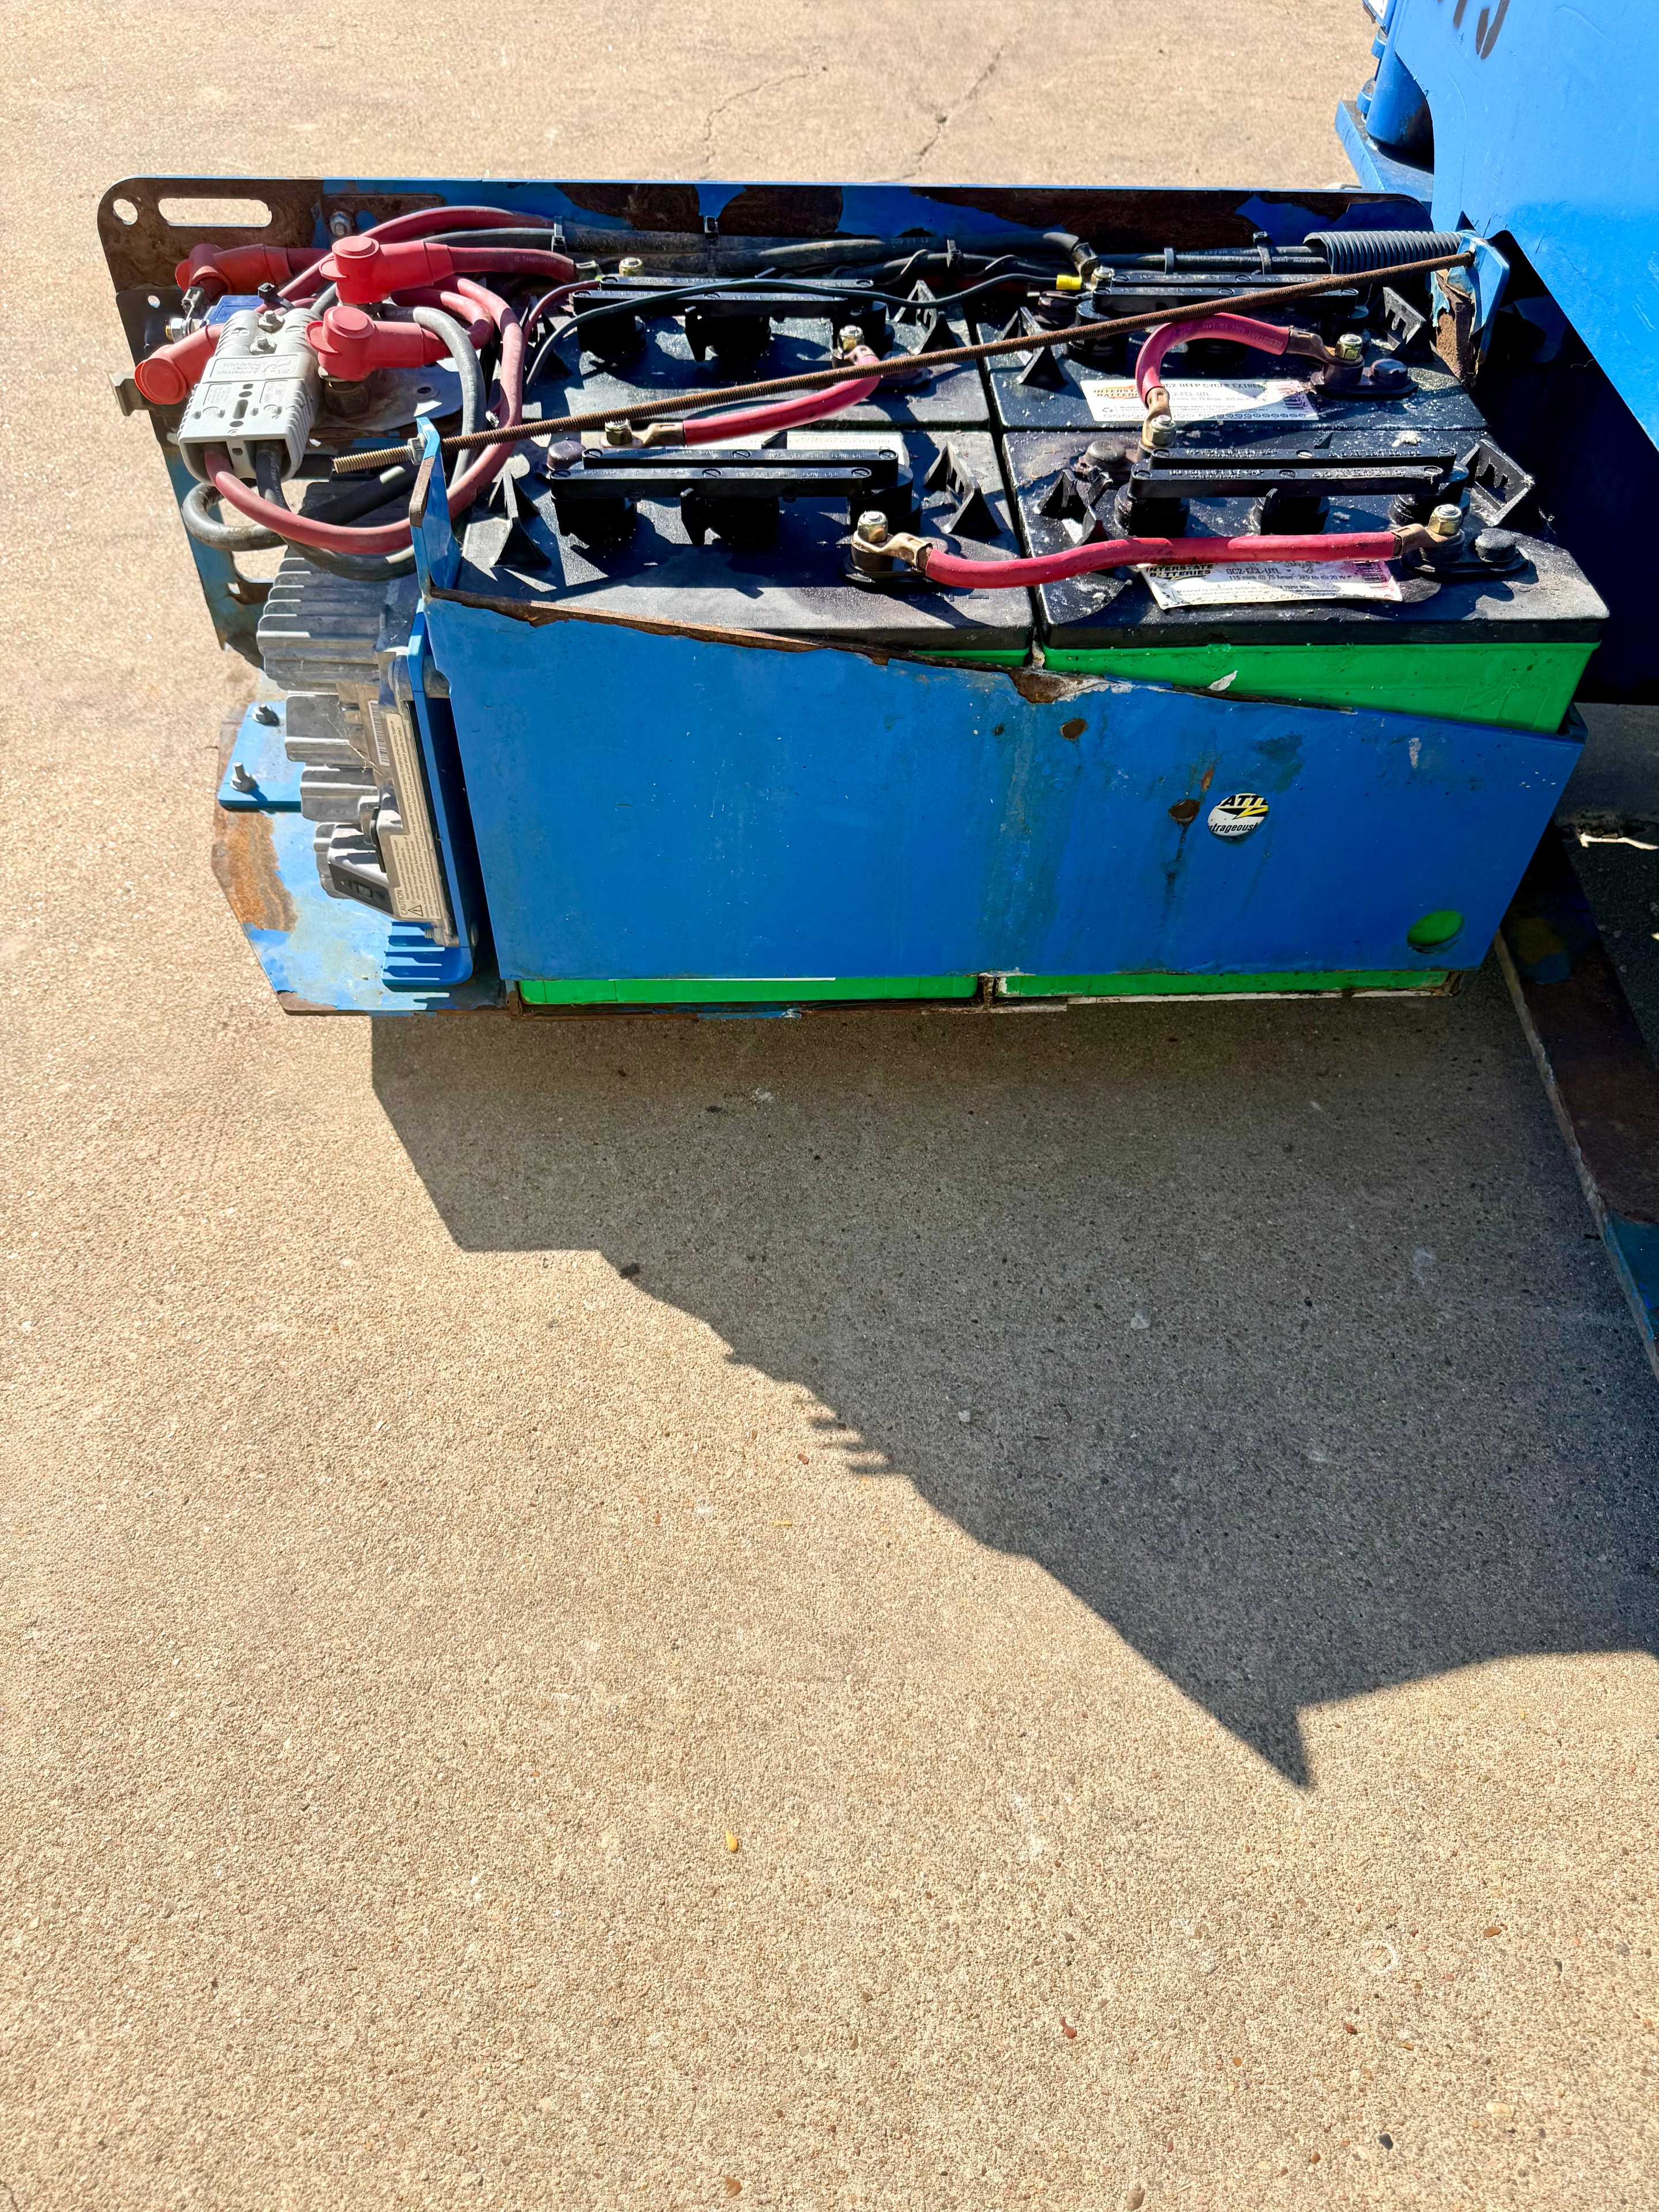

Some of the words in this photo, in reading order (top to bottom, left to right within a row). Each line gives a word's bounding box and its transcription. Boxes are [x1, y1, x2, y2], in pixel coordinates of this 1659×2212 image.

[1248, 330, 1283, 348] RESISTANT
[467, 375, 475, 397] MADE
[1146, 564, 1214, 572] INTERSTATE
[1215, 795, 1268, 806] ATT
[1207, 823, 1259, 834] utrageousl
[396, 890, 407, 915] CAUTION
